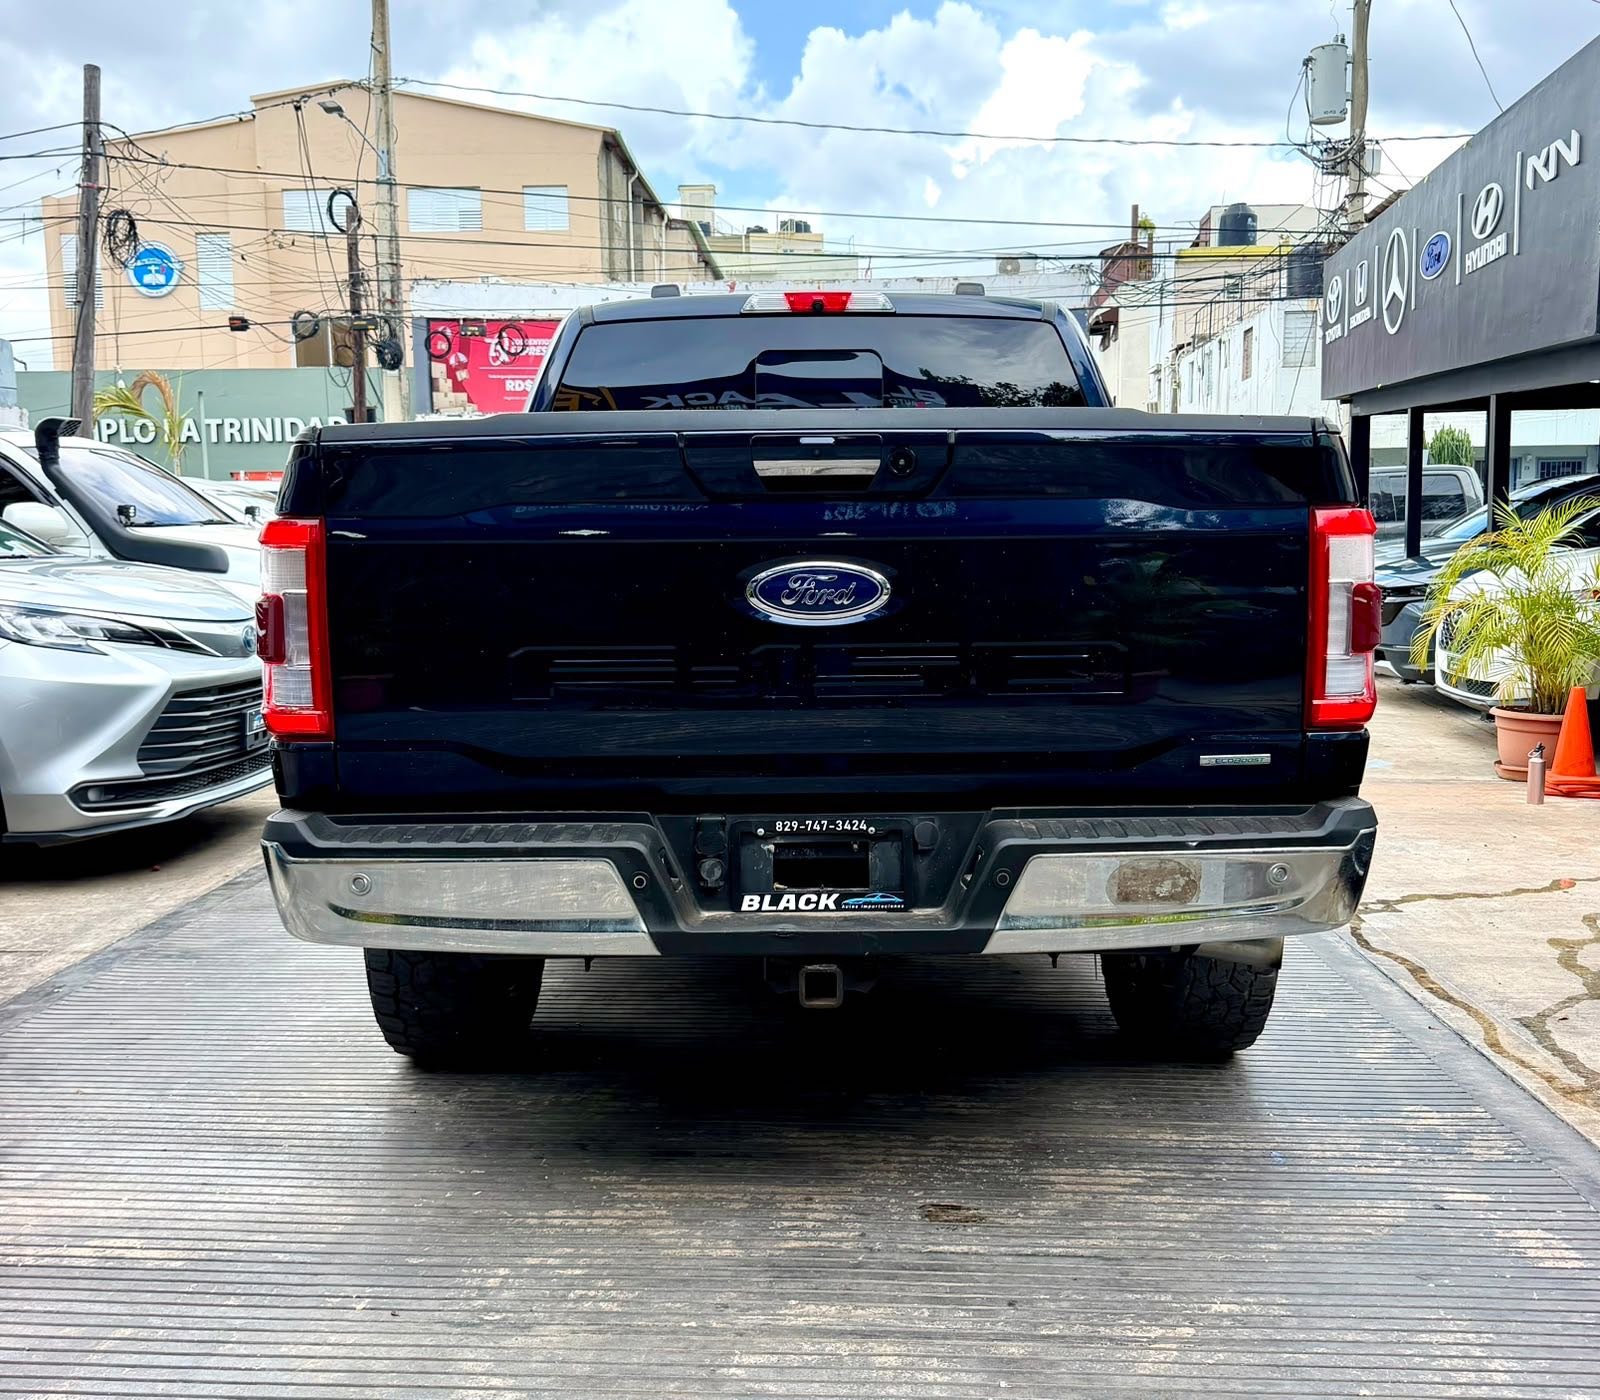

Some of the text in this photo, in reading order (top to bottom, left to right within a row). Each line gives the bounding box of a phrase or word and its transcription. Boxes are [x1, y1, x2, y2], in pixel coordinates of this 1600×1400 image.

[1465, 231, 1508, 275] HYUNDAI
[780, 573, 857, 606] Ford
[775, 819, 868, 832] 829-747-3424
[740, 893, 840, 911] BLACK
